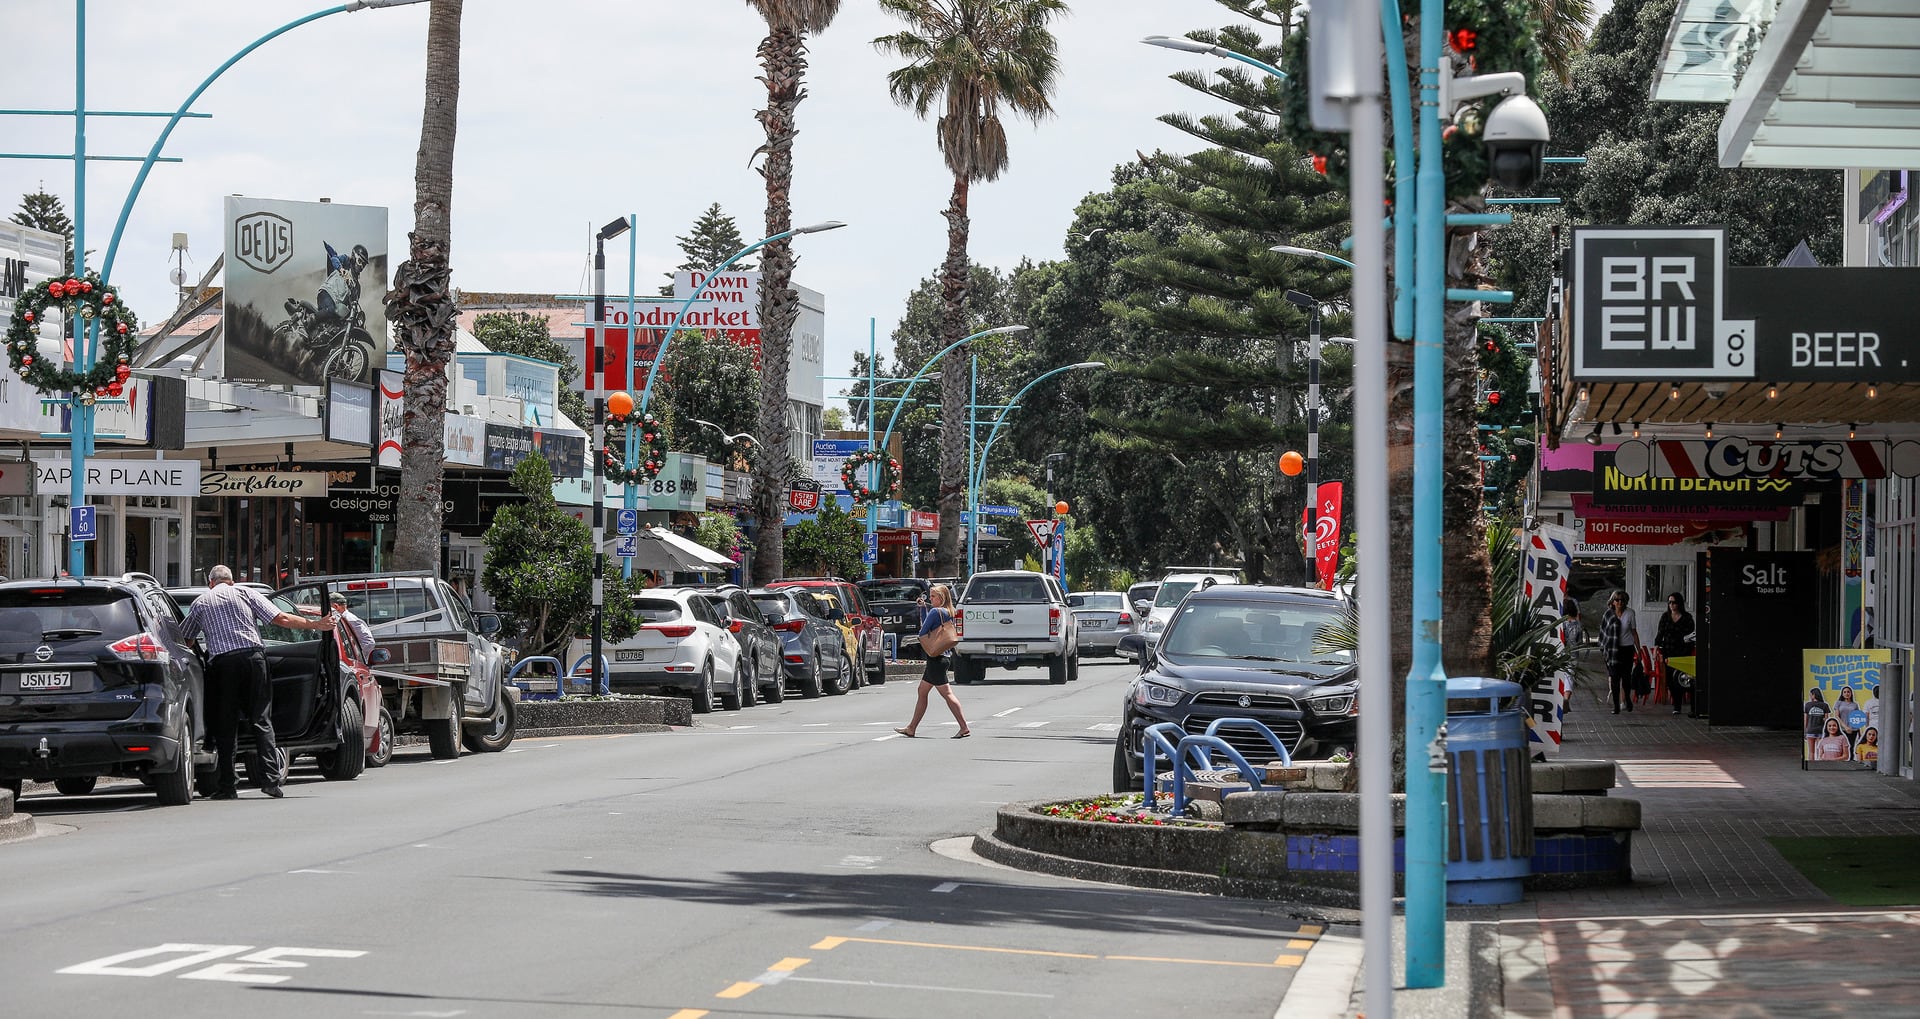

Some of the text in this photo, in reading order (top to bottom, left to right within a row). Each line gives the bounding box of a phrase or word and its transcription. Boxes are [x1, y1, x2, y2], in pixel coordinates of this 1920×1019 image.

[241, 219, 289, 265] DEUS
[690, 272, 749, 289] Down
[603, 306, 751, 327] Foodmarket
[1791, 332, 1882, 368] BEER
[634, 360, 654, 368] zero
[815, 441, 837, 451] Auction
[1706, 436, 1844, 479] CUTS
[37, 468, 183, 486] PAPR PLANE
[200, 472, 304, 495] Surfshop
[652, 479, 677, 494] 88
[329, 497, 393, 512] designer
[981, 505, 1008, 515] Maunganui
[79, 508, 88, 521] P
[368, 513, 390, 522] sizes
[78, 522, 88, 533] 60
[1591, 523, 1685, 534] 101 Foodmarket
[1742, 562, 1787, 586] Salt
[1756, 586, 1787, 594] Tapas Bar
[1825, 655, 1870, 665] MOUNT
[1810, 661, 1881, 675] MAUNGANU
[22, 673, 70, 688] JSN157
[1814, 670, 1881, 691] TEES
